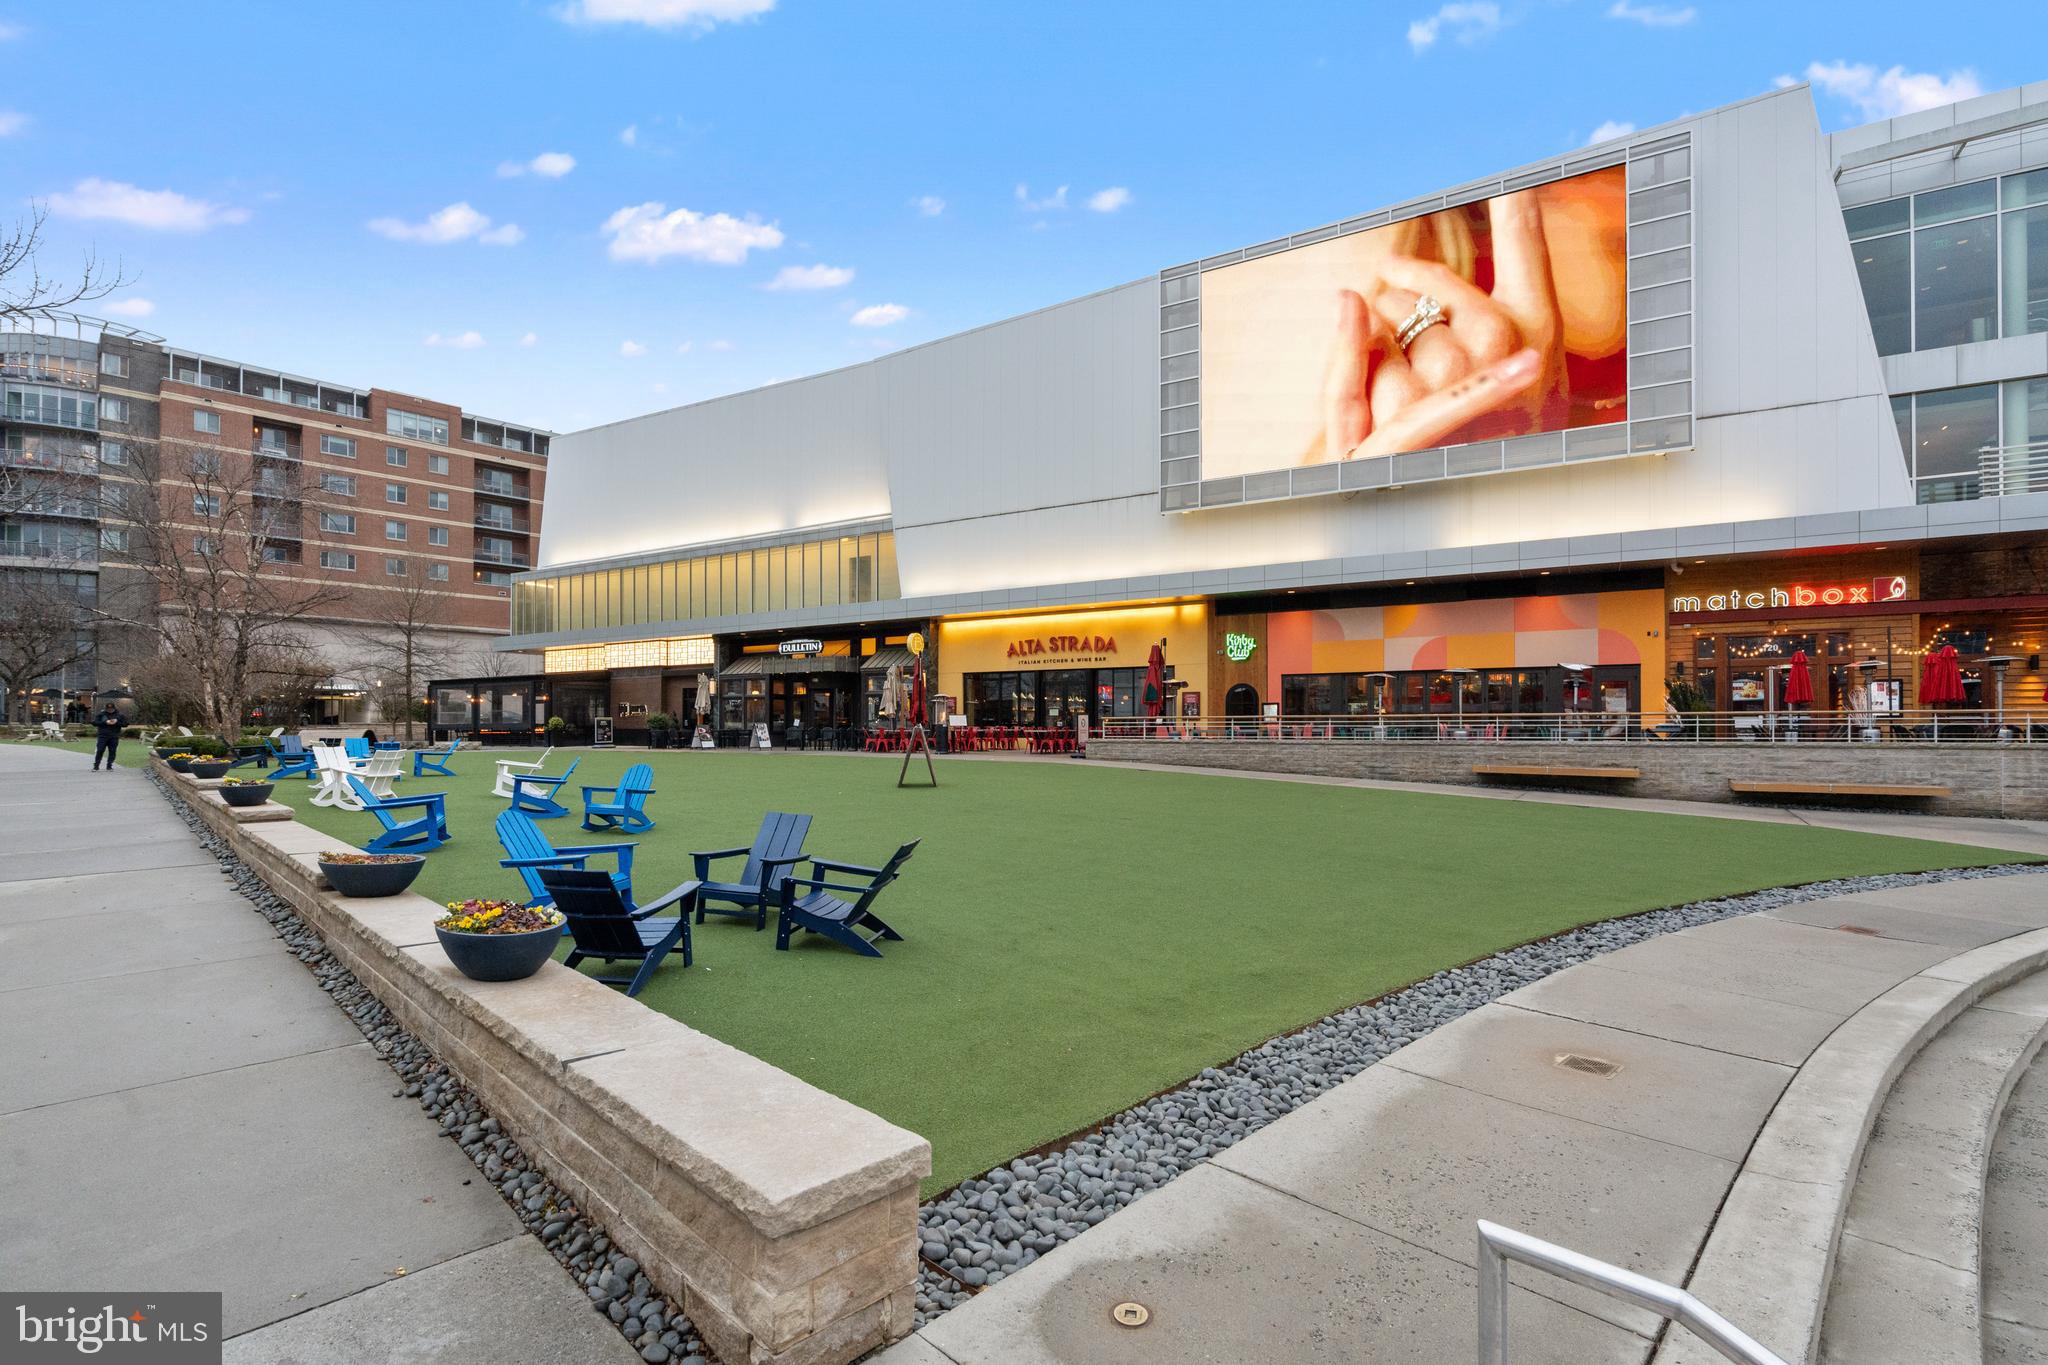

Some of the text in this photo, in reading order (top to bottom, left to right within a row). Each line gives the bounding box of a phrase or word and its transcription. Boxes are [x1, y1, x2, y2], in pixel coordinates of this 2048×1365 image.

[1674, 587, 1868, 612] matchbox
[782, 643, 818, 652] BULLETIN
[1007, 635, 1117, 657] ALTA STRADA
[1227, 634, 1257, 650] Kirby
[1227, 646, 1250, 658] Club
